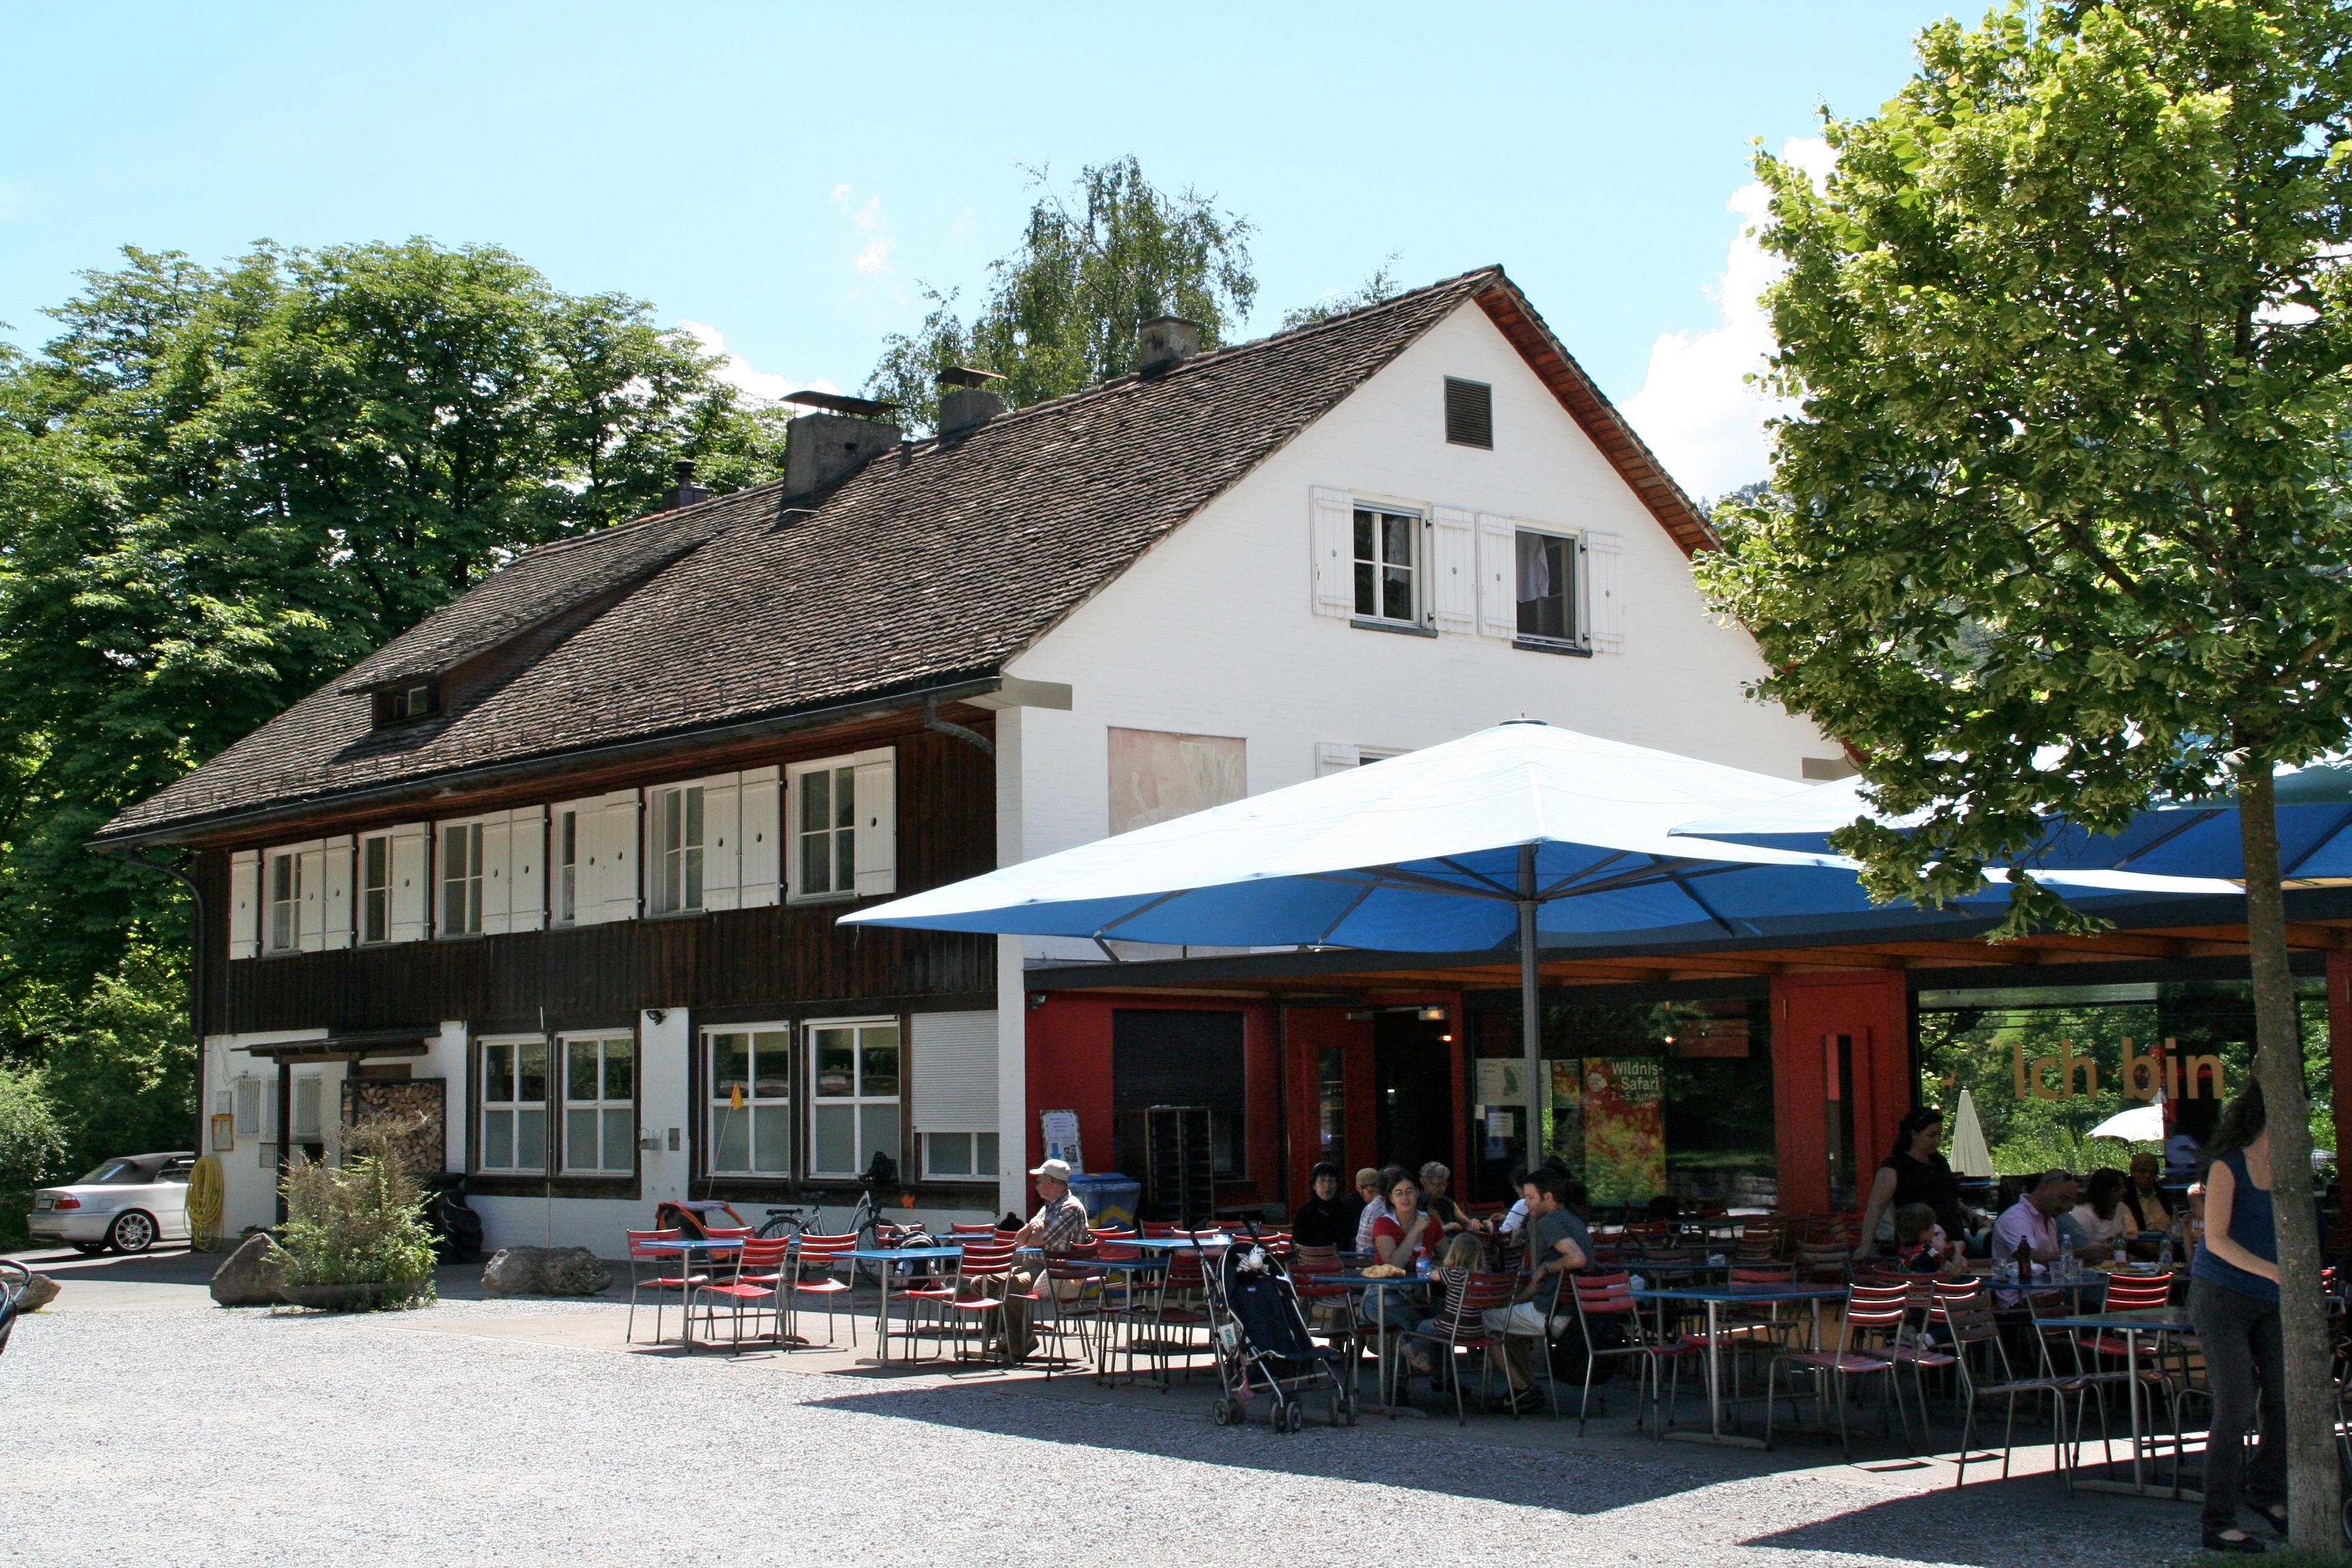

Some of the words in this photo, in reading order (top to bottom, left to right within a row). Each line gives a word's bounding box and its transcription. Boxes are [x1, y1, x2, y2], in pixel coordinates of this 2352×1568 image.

[1612, 1062, 1664, 1075] Wildnis-
[2013, 1038, 2097, 1100] Ich
[2122, 1037, 2225, 1100] bin
[1621, 1077, 1659, 1090] Safari
